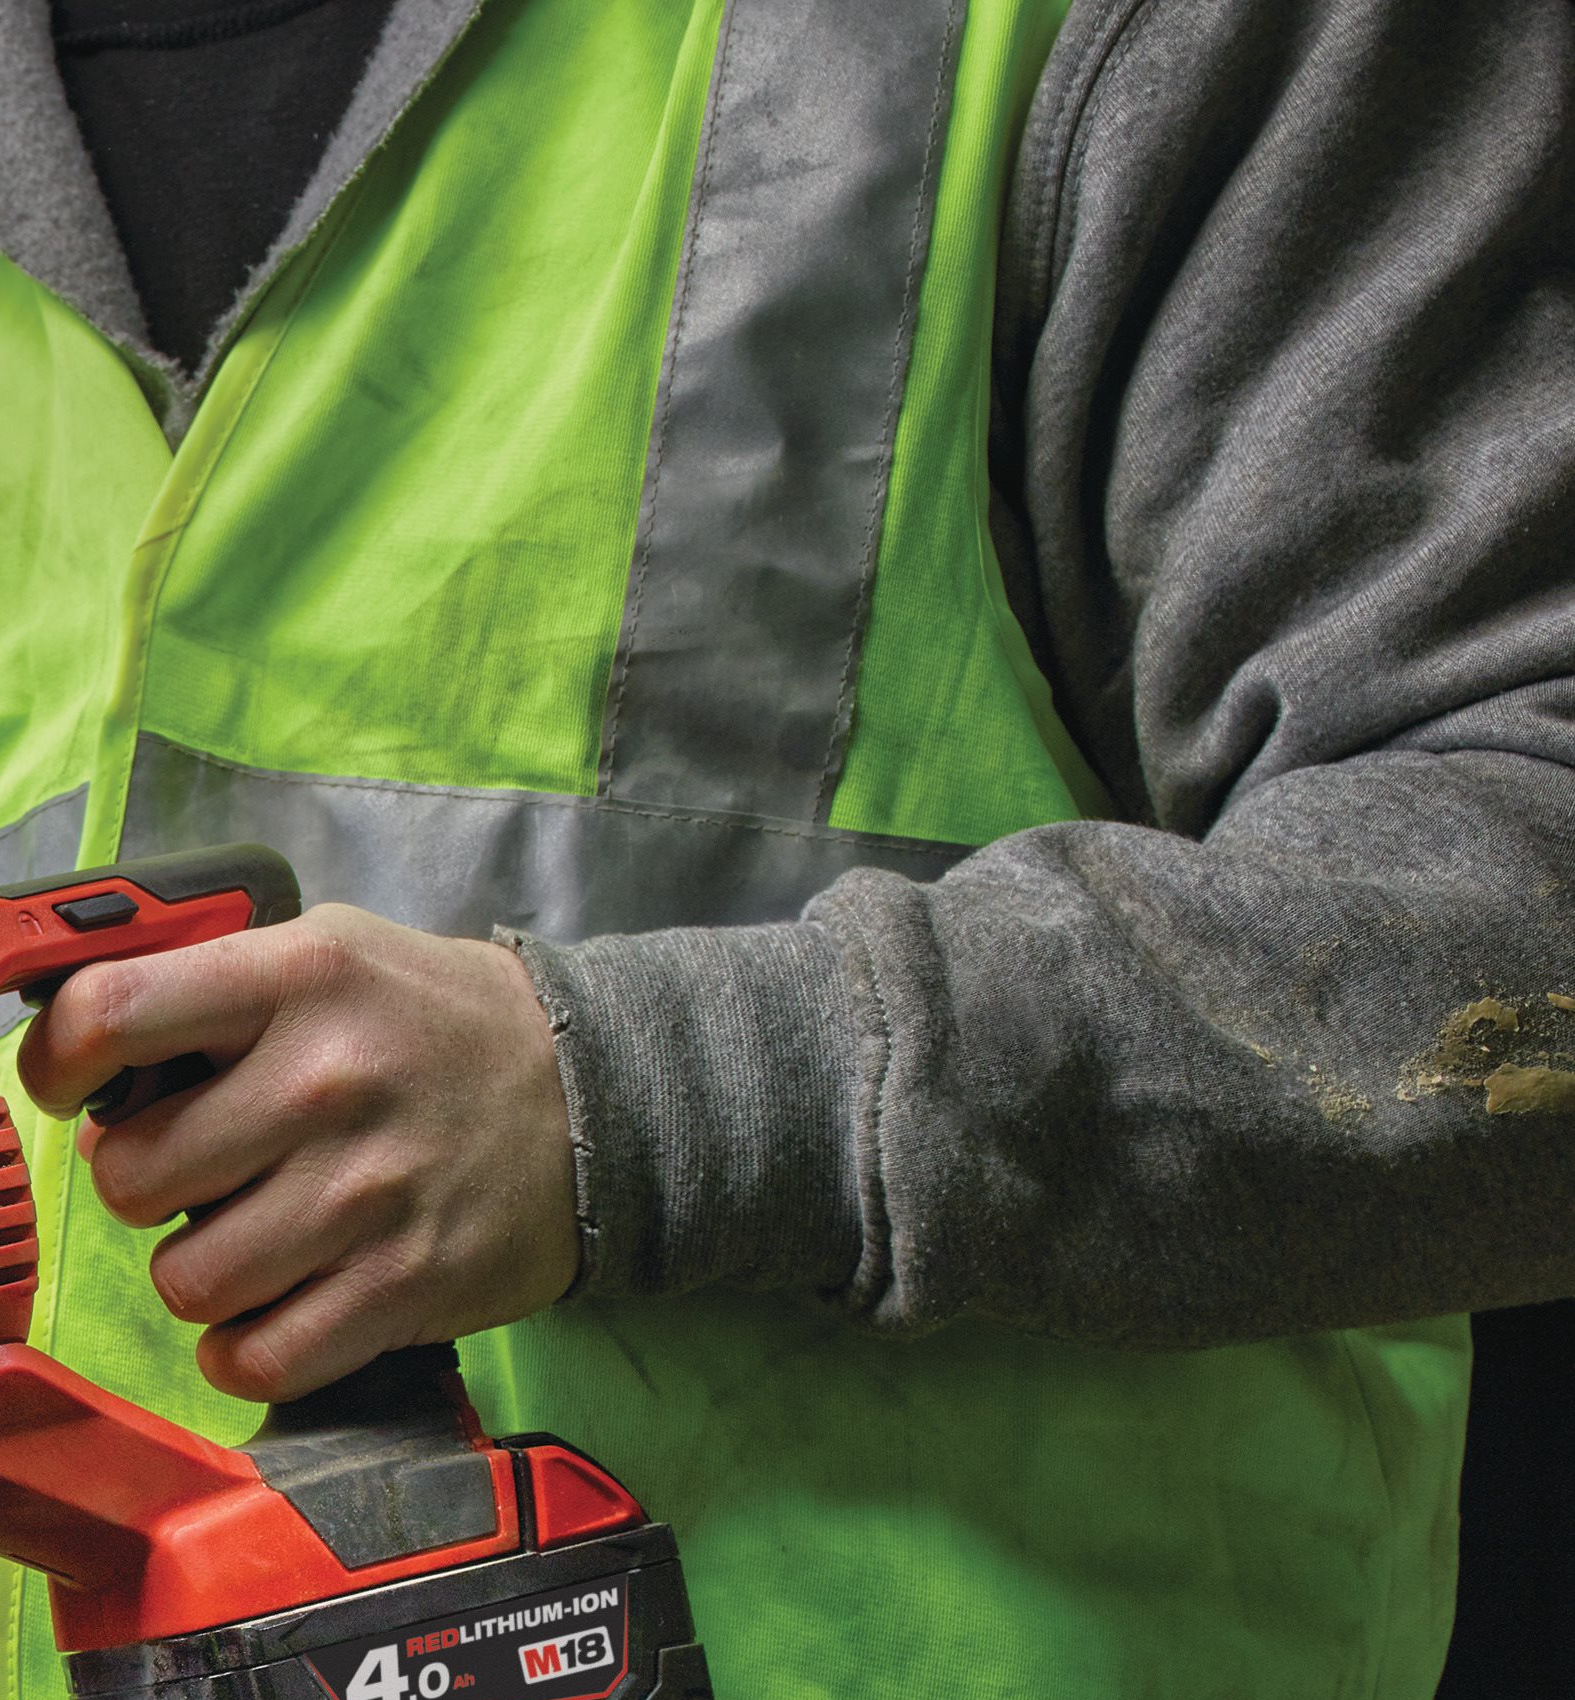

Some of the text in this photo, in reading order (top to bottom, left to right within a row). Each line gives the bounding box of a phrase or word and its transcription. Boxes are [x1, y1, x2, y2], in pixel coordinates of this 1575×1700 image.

[406, 1587, 619, 1658] REDLITHIUM-ION
[523, 1632, 607, 1679] M18
[453, 1672, 475, 1690] Ah
